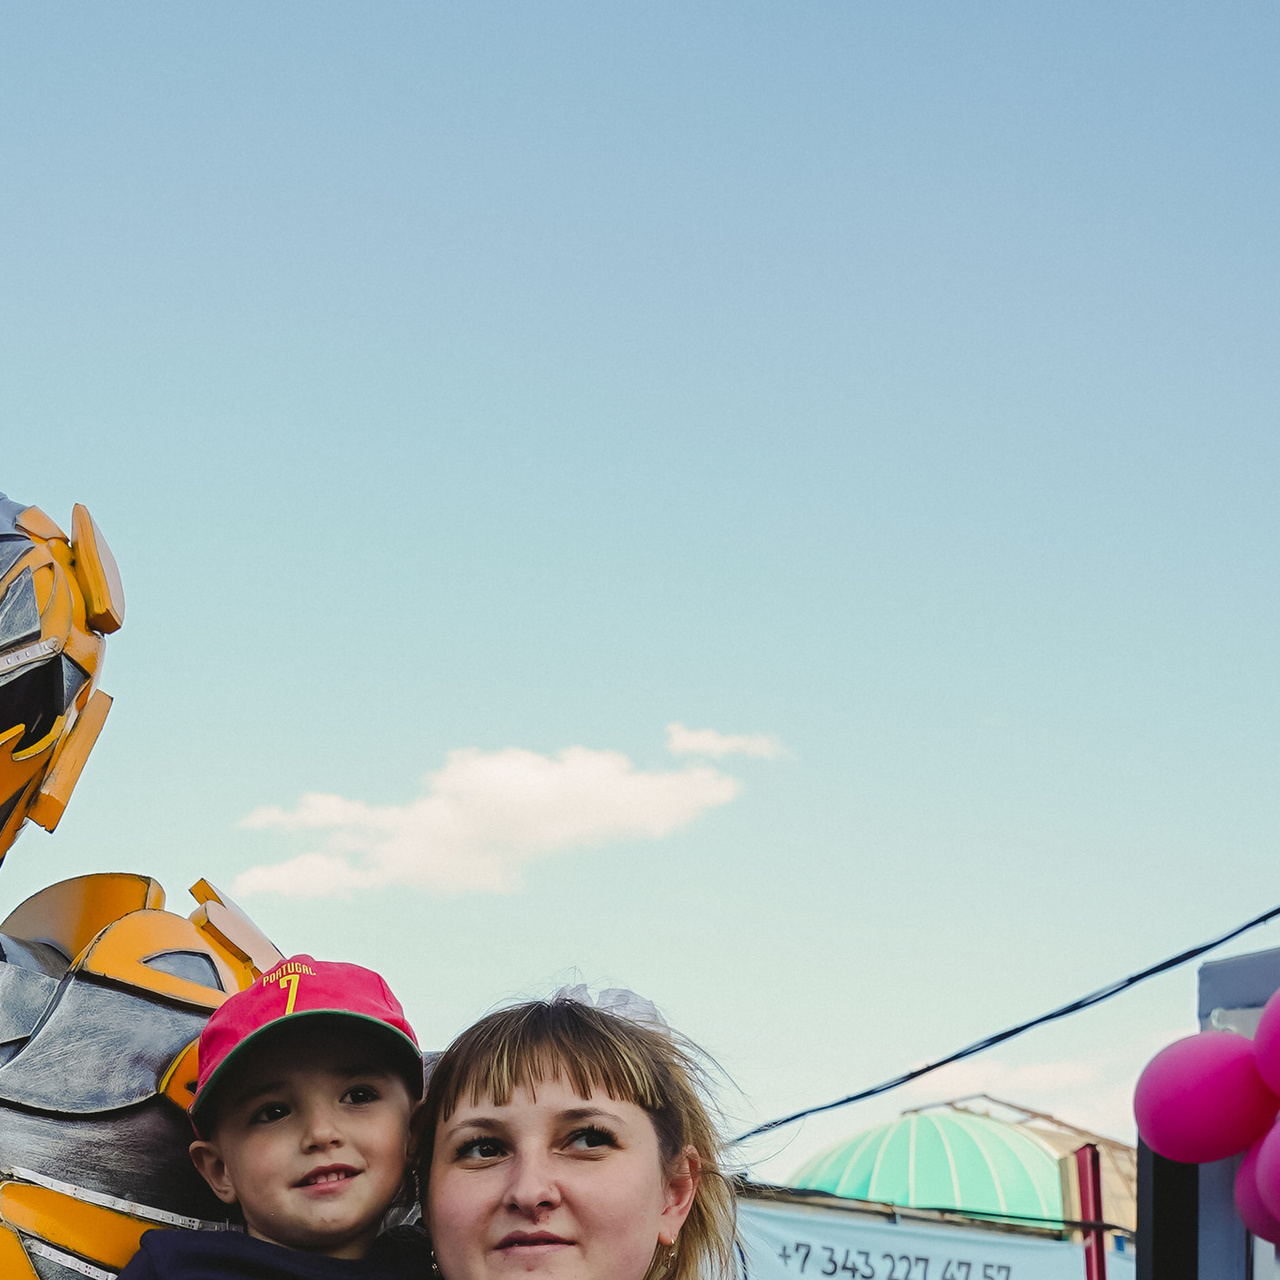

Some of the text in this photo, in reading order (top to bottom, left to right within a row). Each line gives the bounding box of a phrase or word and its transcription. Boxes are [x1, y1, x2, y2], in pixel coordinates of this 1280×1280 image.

[279, 973, 300, 1016] 7
[779, 1242, 812, 1274] +7
[821, 1246, 876, 1280] 343
